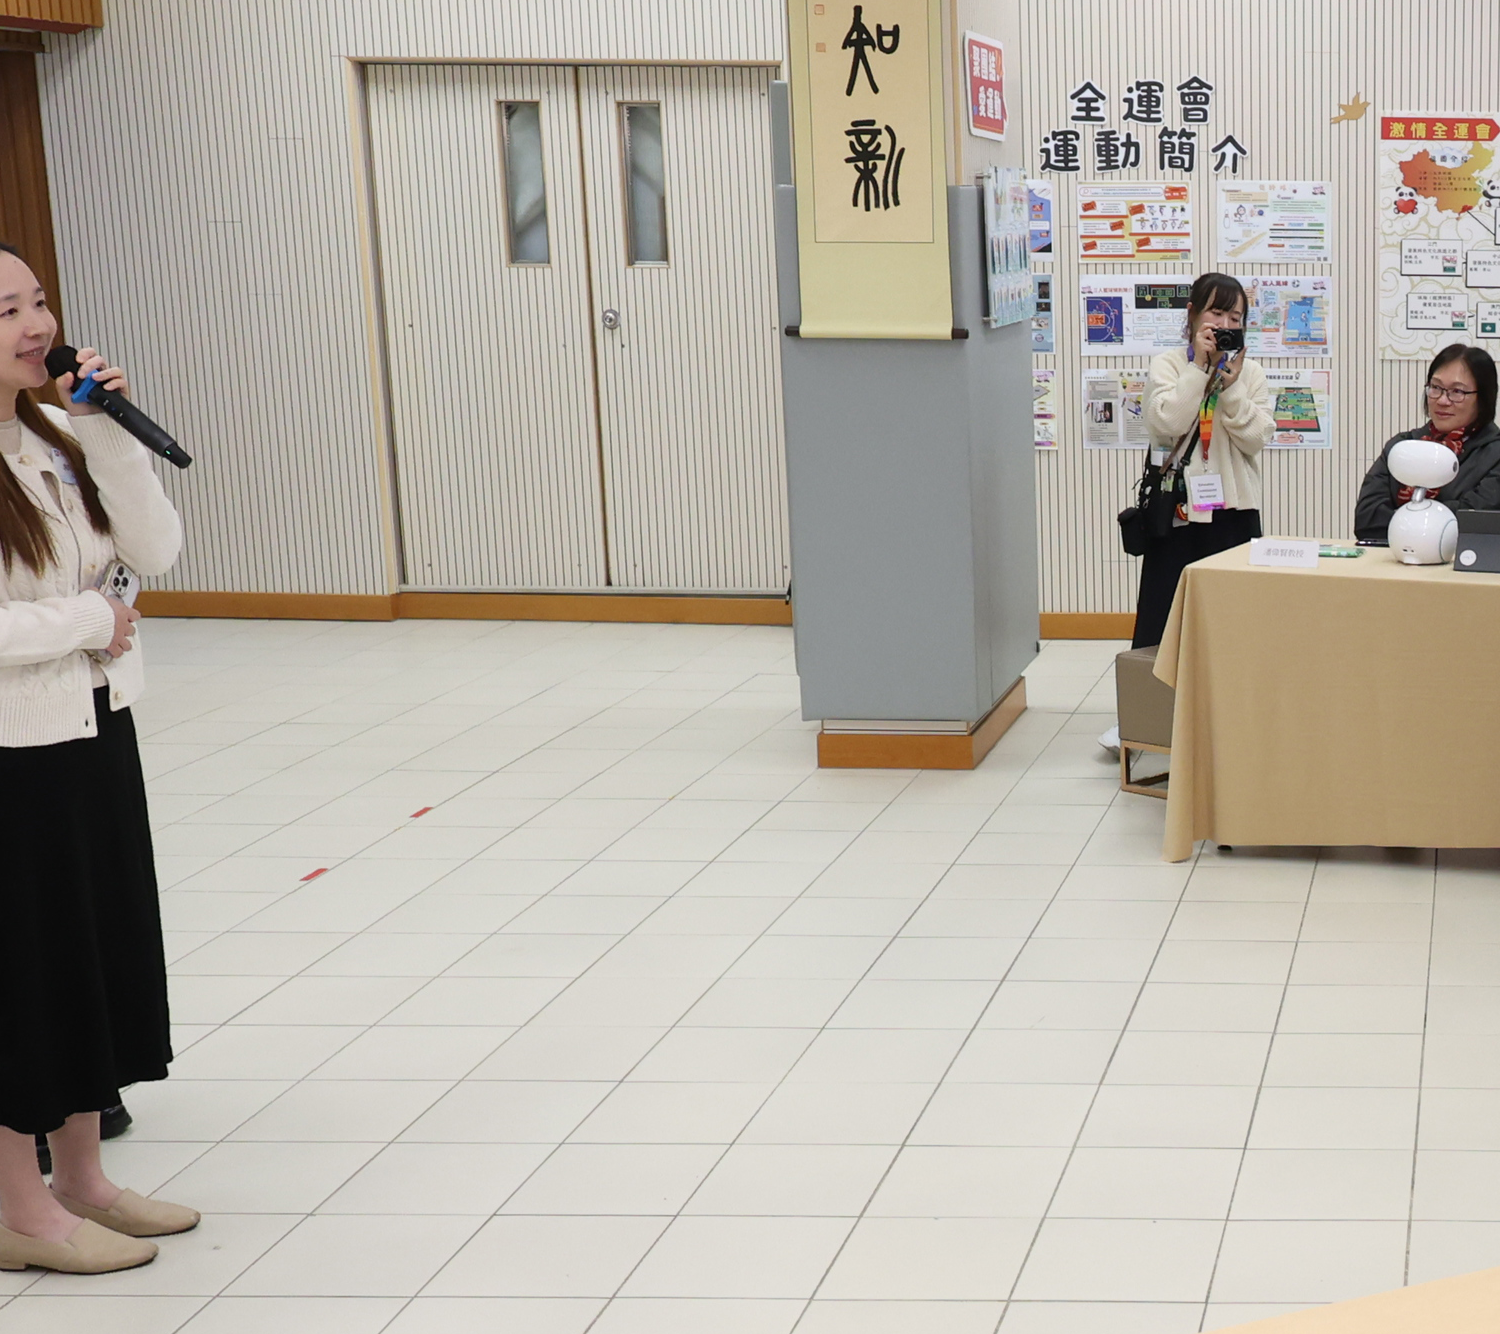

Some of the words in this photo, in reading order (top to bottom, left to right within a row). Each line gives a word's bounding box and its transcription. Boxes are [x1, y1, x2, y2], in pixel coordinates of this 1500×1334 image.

[1070, 76, 1213, 123] 全運會
[1040, 126, 1247, 174] 運動簡介
[1389, 122, 1491, 139] 激情全運會
